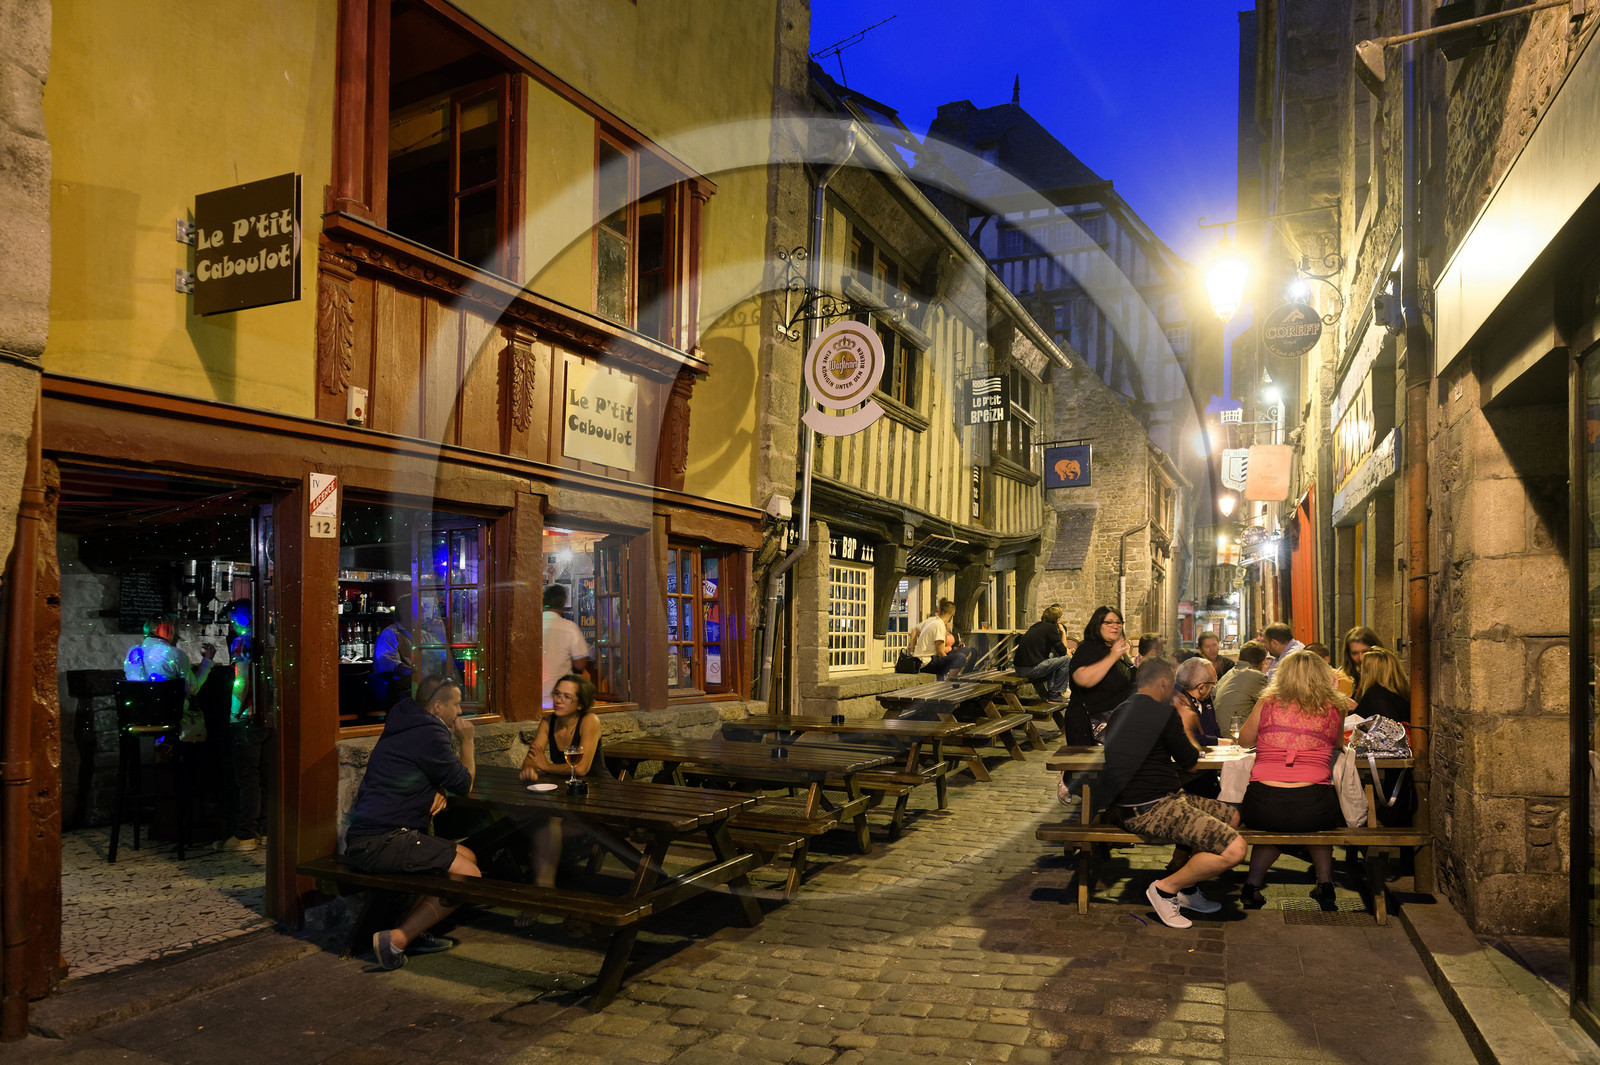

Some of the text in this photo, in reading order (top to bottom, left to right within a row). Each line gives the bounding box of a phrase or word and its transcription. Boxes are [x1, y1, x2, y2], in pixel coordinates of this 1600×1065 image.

[197, 208, 292, 250] Le P'tit
[196, 244, 291, 282] Caboulot
[1265, 323, 1320, 339] COREFF
[823, 350, 832, 363] EINE
[853, 371, 863, 382] DEN
[569, 389, 589, 410] Le
[972, 398, 982, 408] Le
[568, 414, 632, 446] Caboulot
[313, 480, 320, 488] IV
[313, 481, 335, 508] LICENCE
[317, 522, 331, 534] 12
[584, 579, 595, 589] Pul
